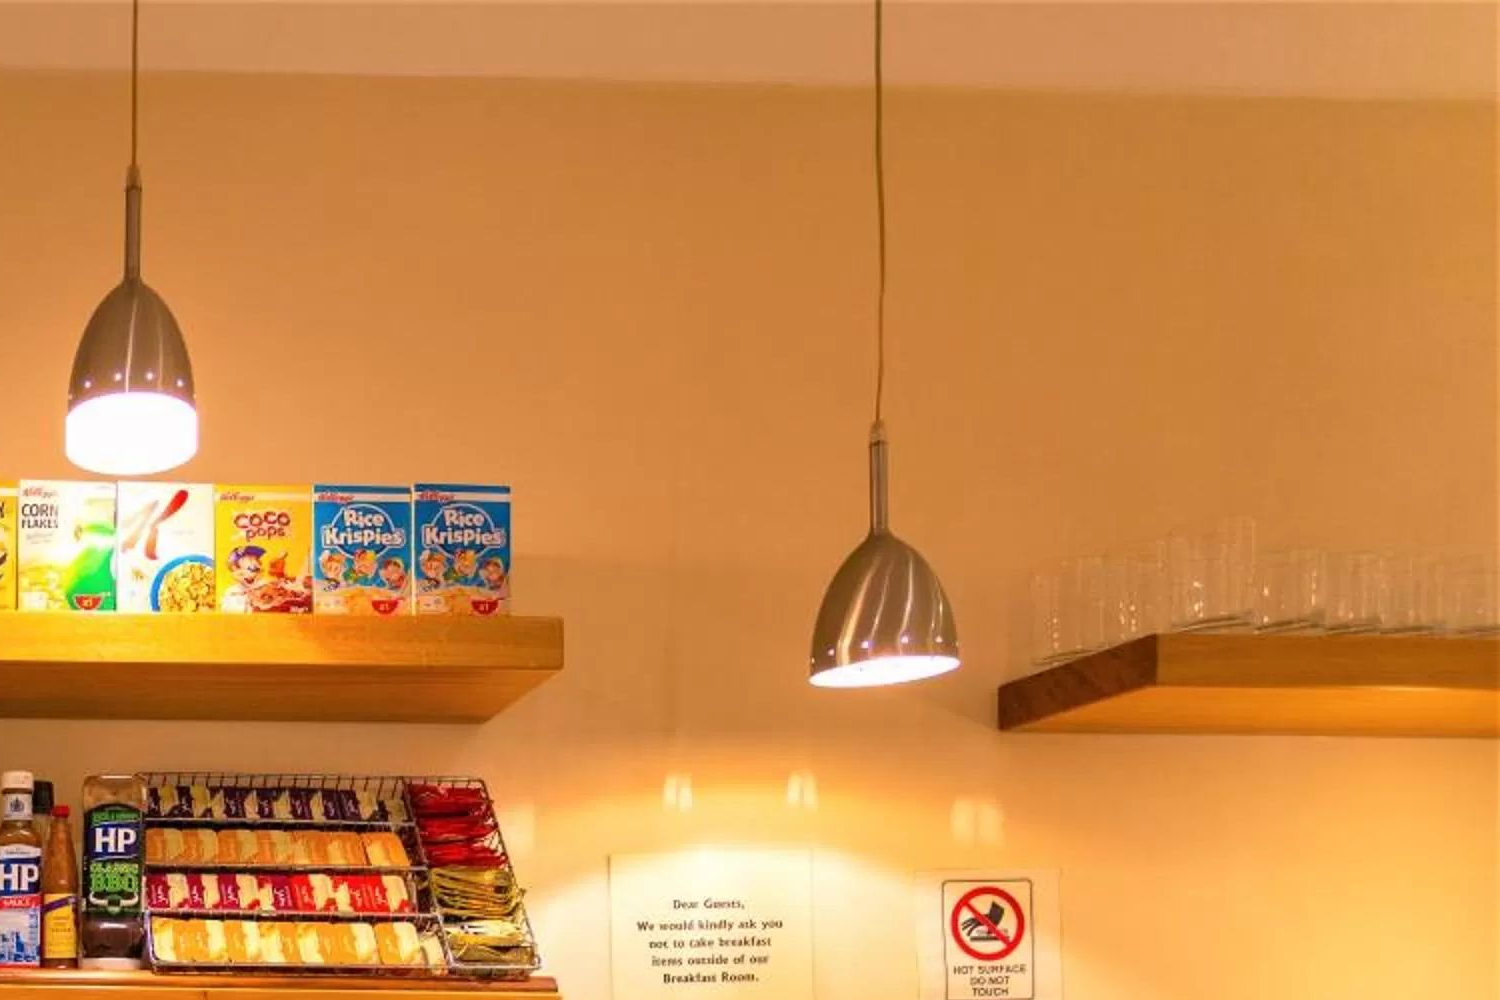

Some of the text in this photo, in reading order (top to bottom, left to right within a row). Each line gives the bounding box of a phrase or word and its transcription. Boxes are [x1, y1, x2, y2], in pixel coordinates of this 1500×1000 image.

[21, 503, 59, 517] CORN
[21, 518, 59, 529] FLAKES
[343, 509, 385, 528] Rice
[443, 508, 485, 528] Rice
[323, 526, 404, 546] Krispies
[423, 526, 504, 546] Krispies
[94, 827, 137, 853] HP
[91, 874, 139, 893] BBQ
[672, 898, 746, 910] Dear Guests,
[636, 919, 784, 932] We would kindly ask you
[648, 936, 772, 949] not to take breakfast
[651, 954, 769, 967] items outside of our
[953, 964, 1027, 975] HOT SURFACE
[663, 971, 760, 984] Breakfast Room.
[969, 975, 1010, 985] DO NOT
[972, 987, 1009, 997] TOUCH
